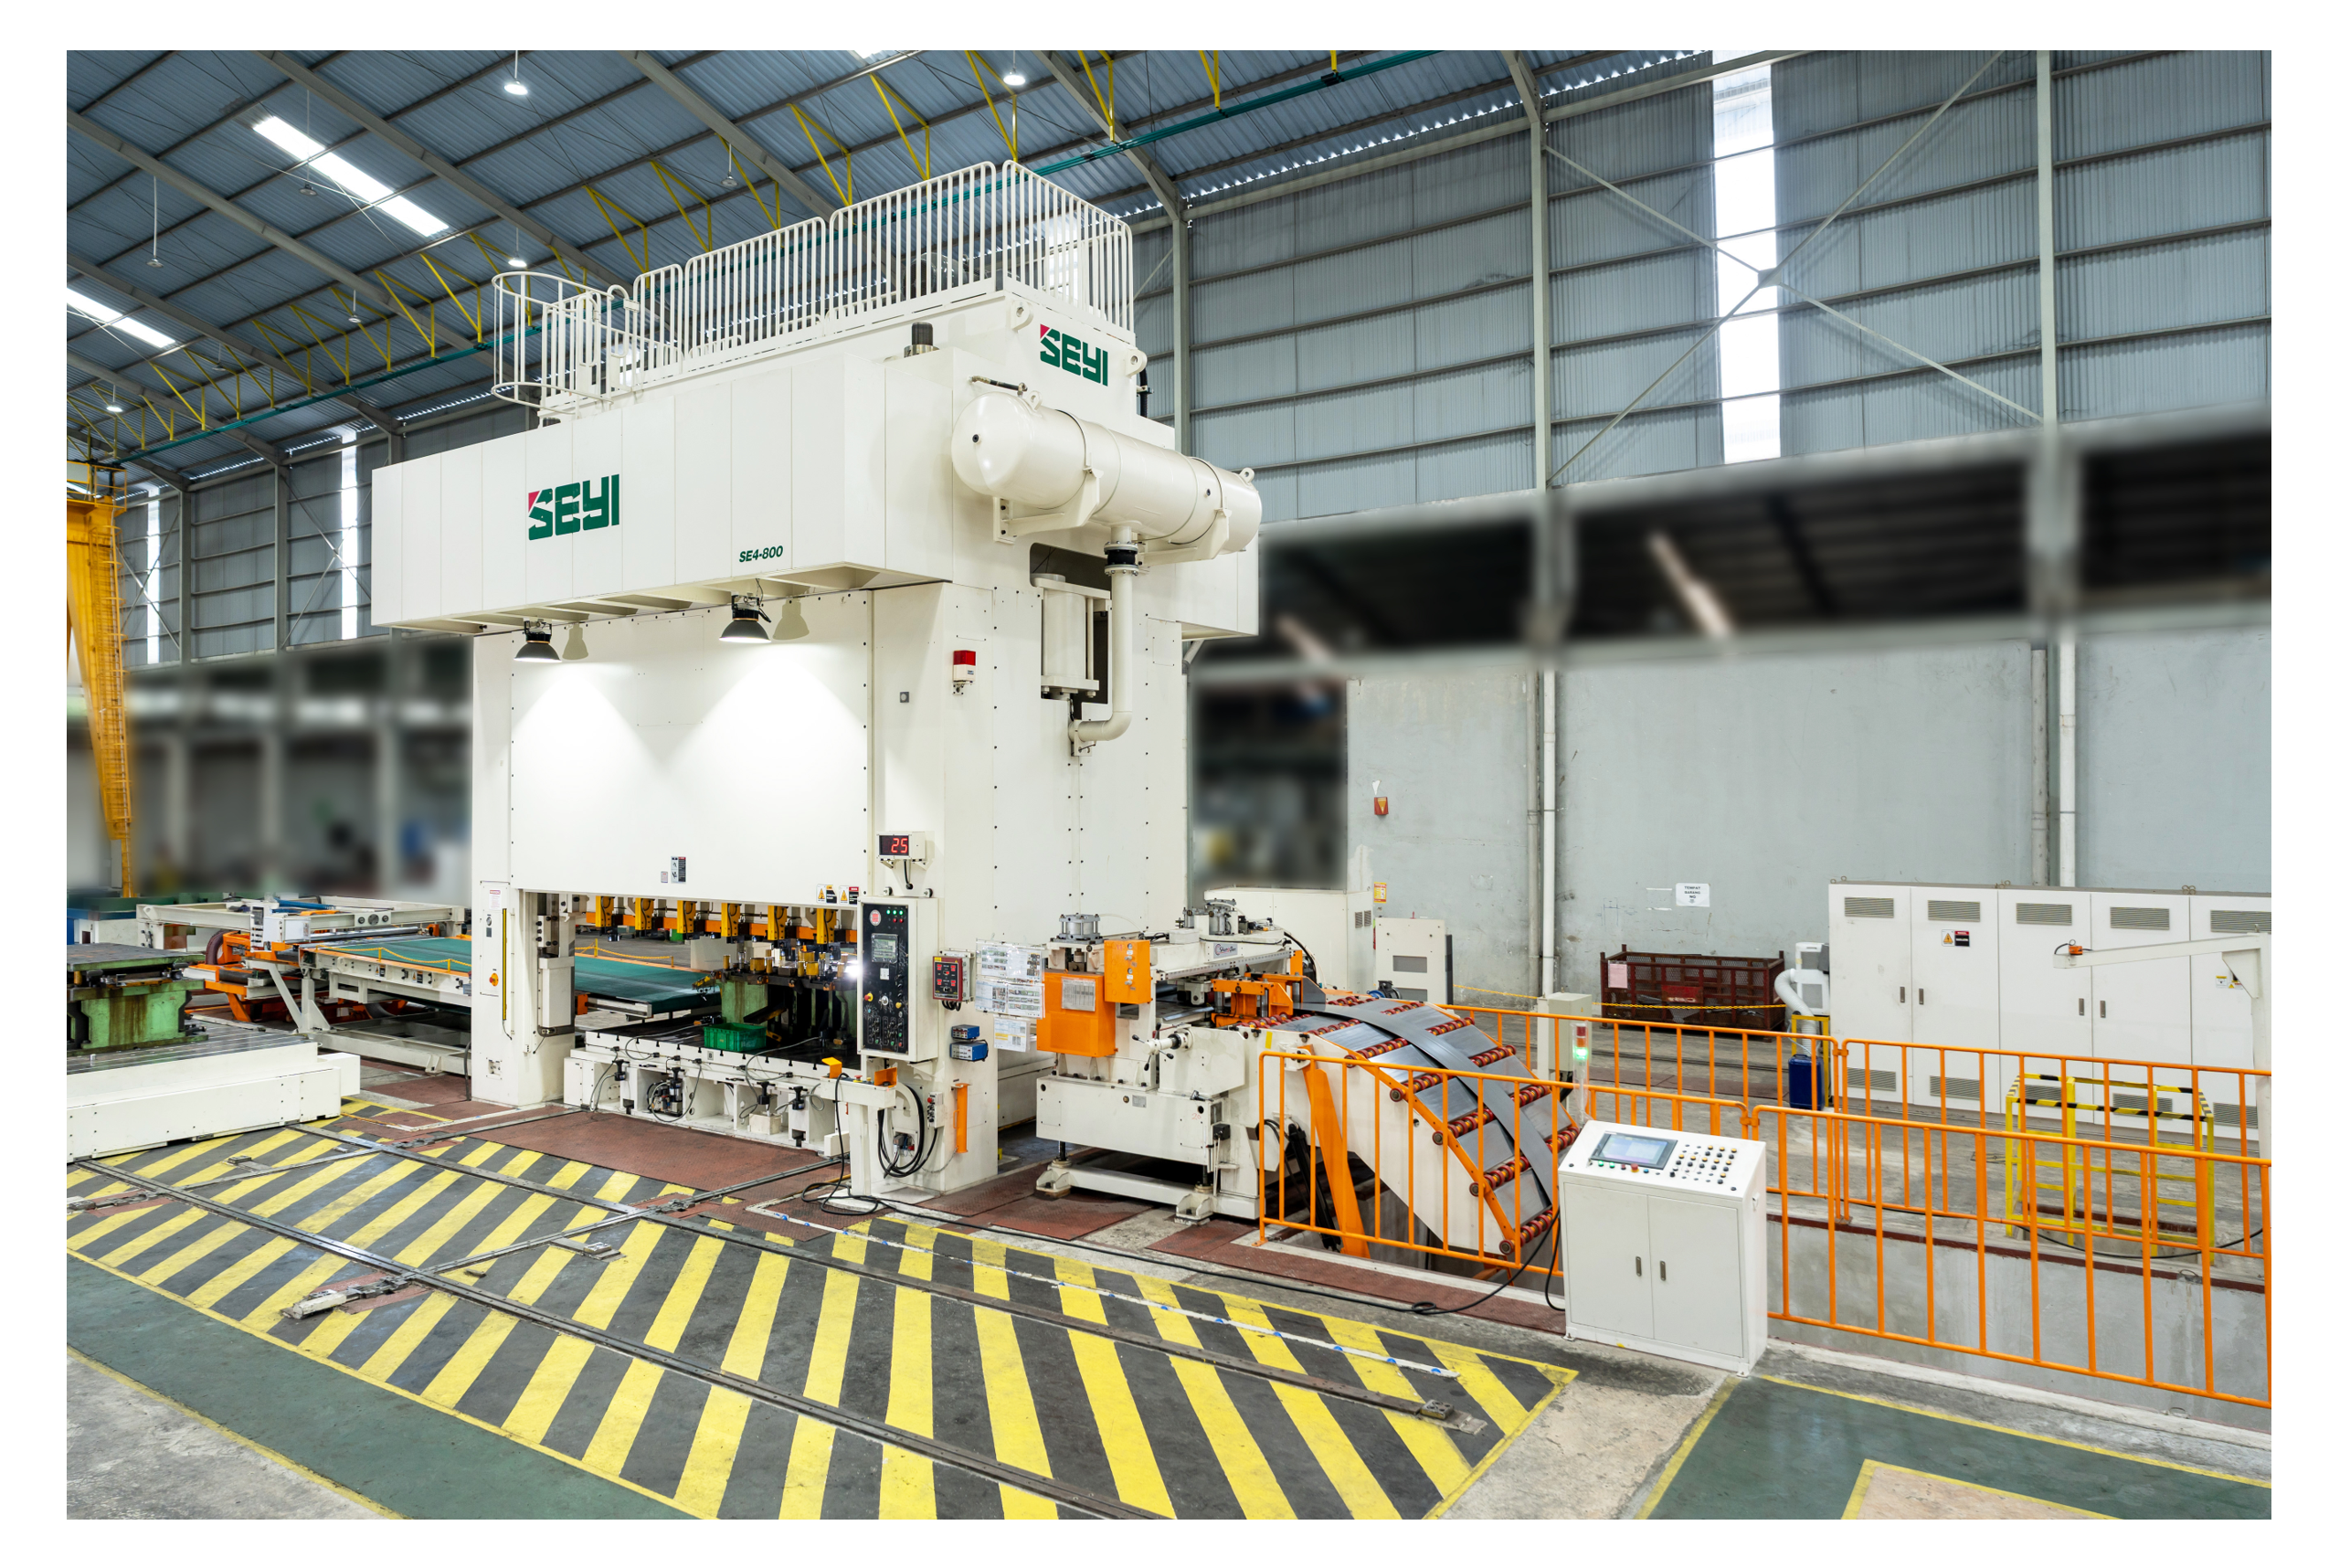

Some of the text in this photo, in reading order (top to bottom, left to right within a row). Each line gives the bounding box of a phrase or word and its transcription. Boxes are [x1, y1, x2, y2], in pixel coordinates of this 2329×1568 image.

[1040, 323, 1108, 387] SEYI
[528, 473, 620, 541] SEYI
[738, 545, 784, 563] SE4-800
[891, 837, 908, 853] 25
